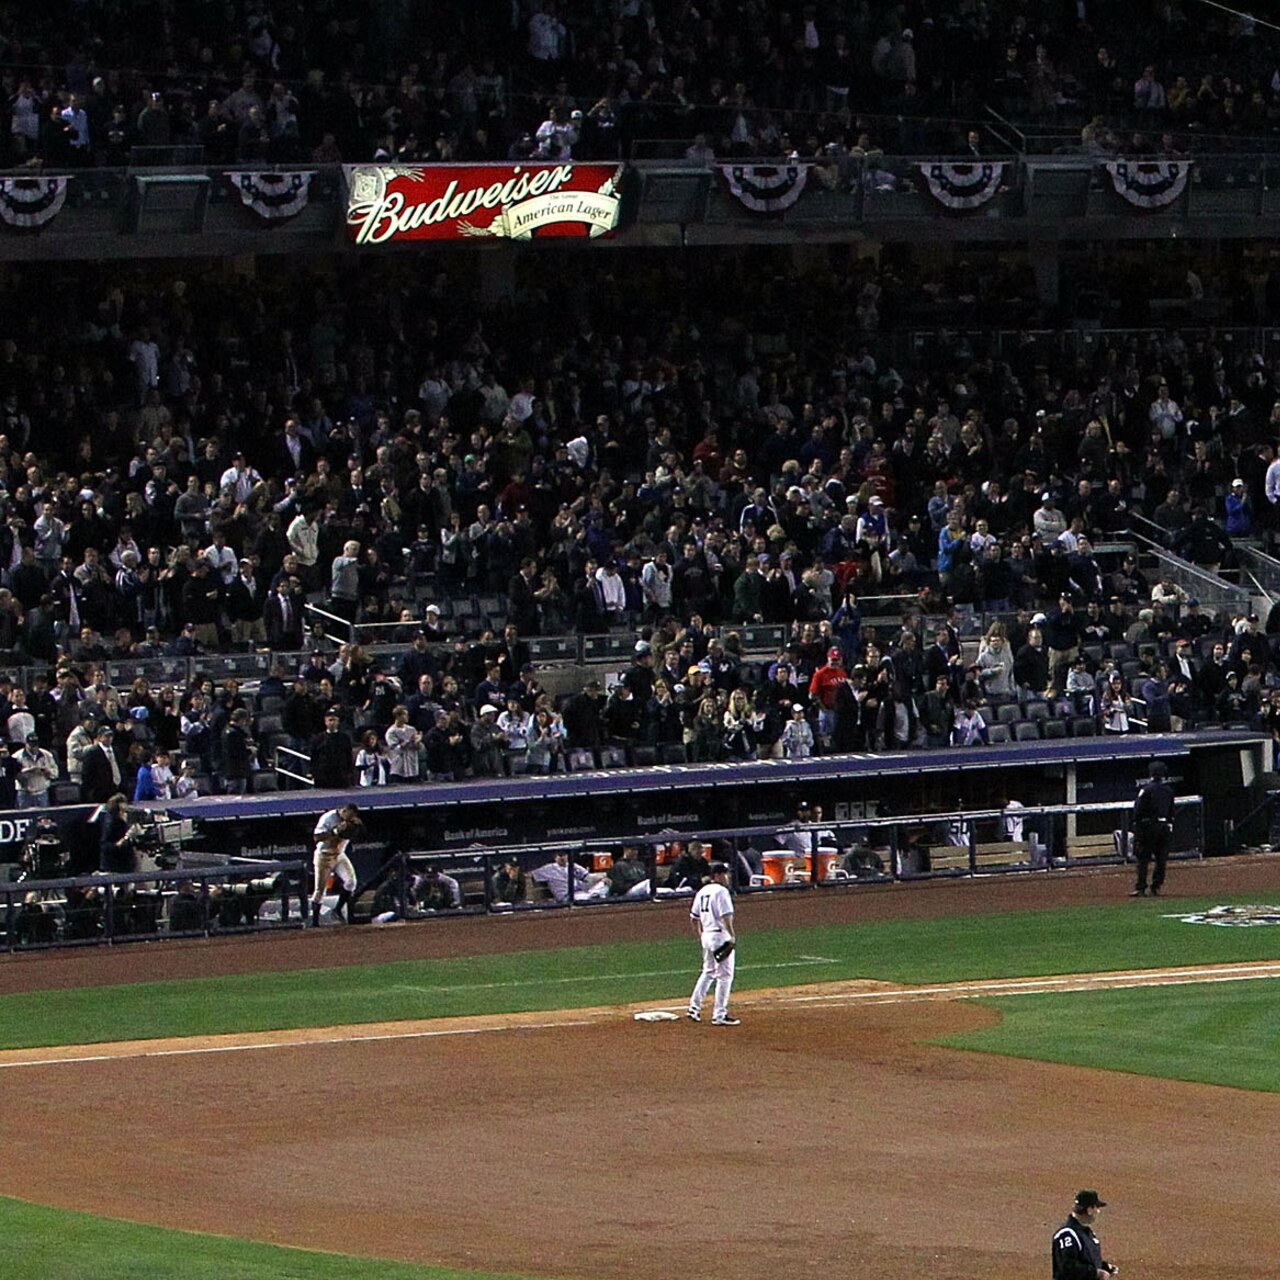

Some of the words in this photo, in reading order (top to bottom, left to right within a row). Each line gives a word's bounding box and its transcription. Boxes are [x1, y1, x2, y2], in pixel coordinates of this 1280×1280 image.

[347, 164, 573, 245] Budweiser
[513, 202, 574, 229] American
[576, 200, 612, 220] Lager
[637, 814, 656, 826] Bank
[667, 812, 699, 824] America
[443, 828, 464, 841] Bank
[474, 826, 508, 839] America
[240, 844, 261, 857] Bank
[272, 843, 308, 855] America
[700, 894, 711, 913] 17
[1060, 1236, 1073, 1250] 12
